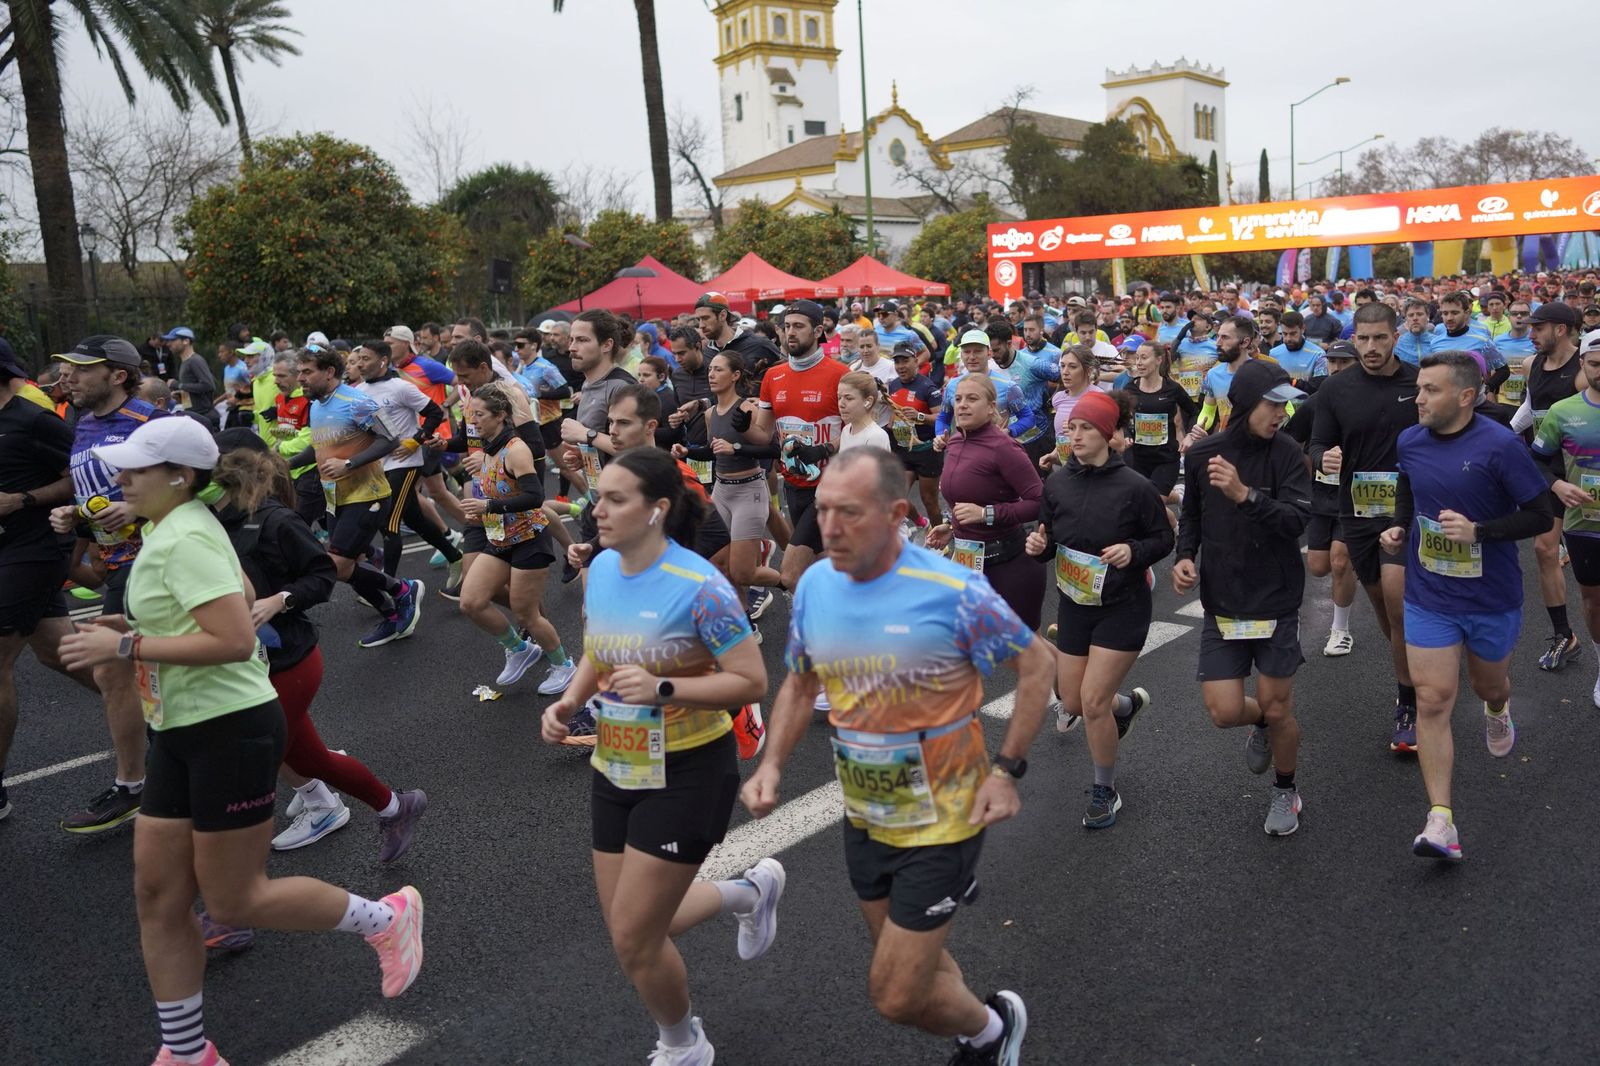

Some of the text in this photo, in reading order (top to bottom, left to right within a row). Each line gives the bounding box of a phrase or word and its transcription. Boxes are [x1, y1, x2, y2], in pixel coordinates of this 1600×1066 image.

[1405, 203, 1462, 224] HOKA
[1355, 483, 1395, 499] 11753
[1061, 556, 1090, 586] 9092
[842, 760, 912, 793] 10554
